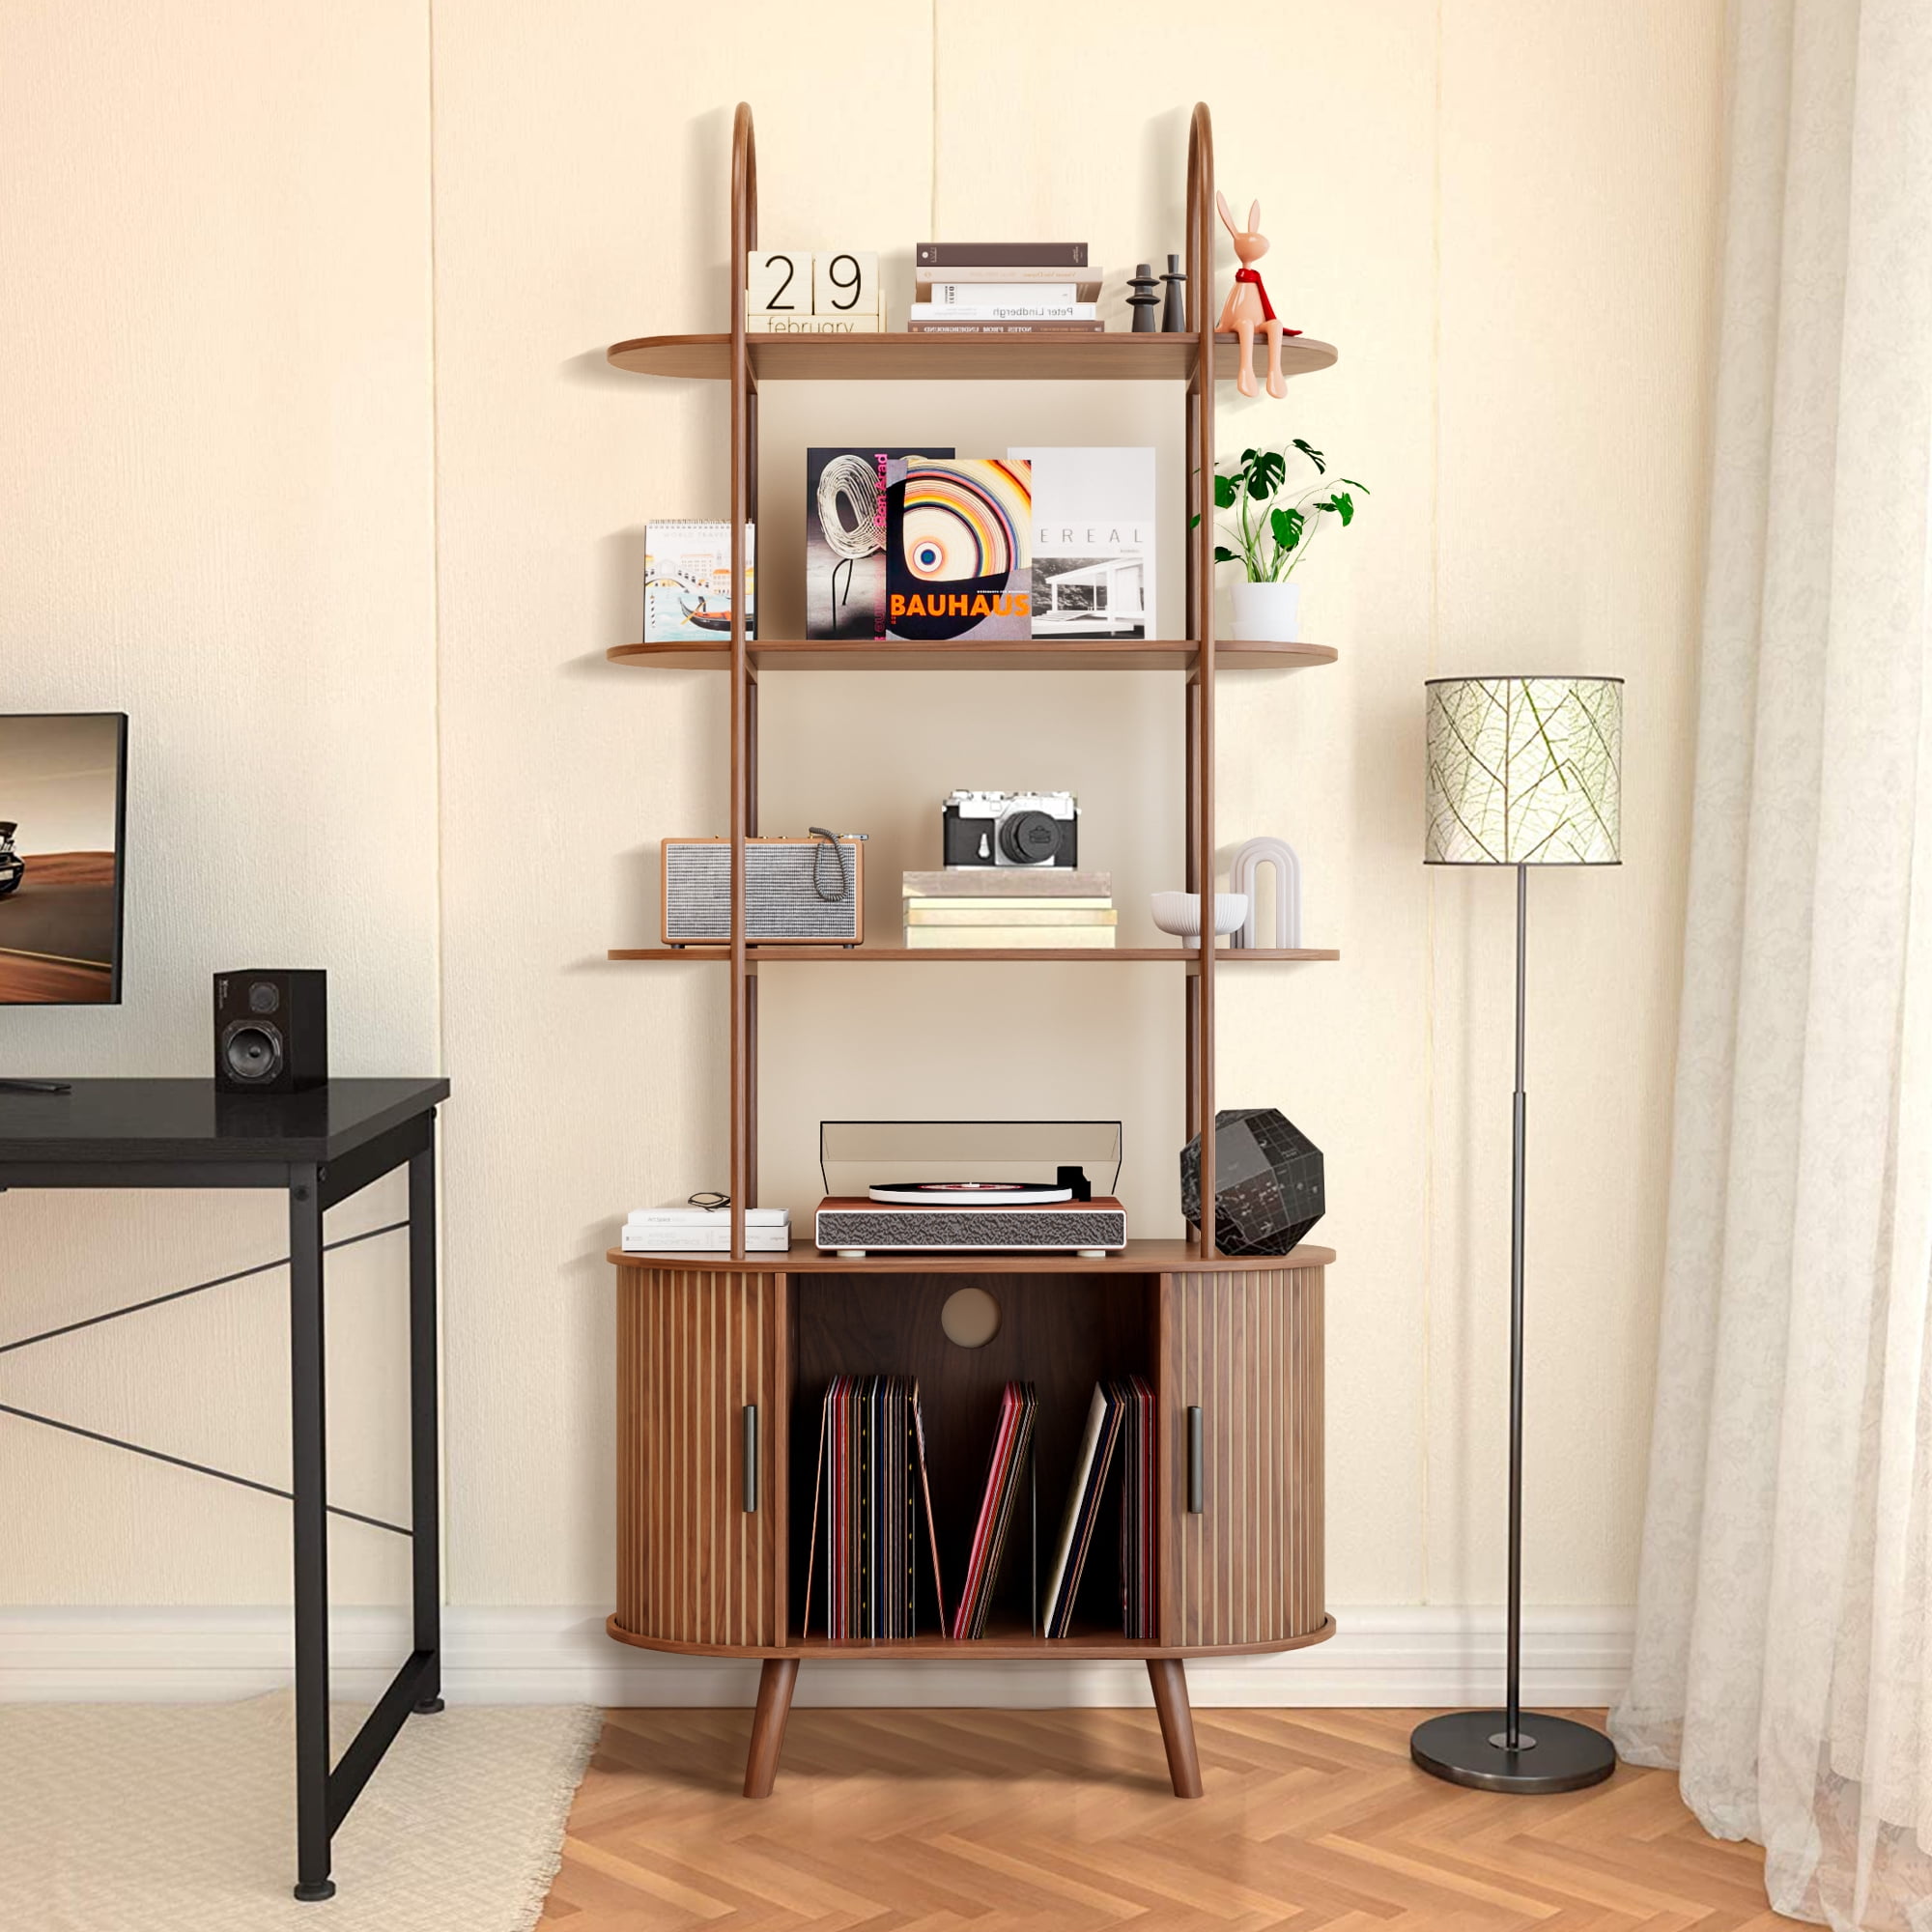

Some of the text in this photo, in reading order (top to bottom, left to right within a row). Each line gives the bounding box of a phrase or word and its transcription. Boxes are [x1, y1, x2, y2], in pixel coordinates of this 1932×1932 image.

[767, 316, 855, 333] february
[873, 453, 888, 526] Ron Arad
[1040, 527, 1144, 543] EREAL
[890, 593, 1031, 616] BAUHAUS
